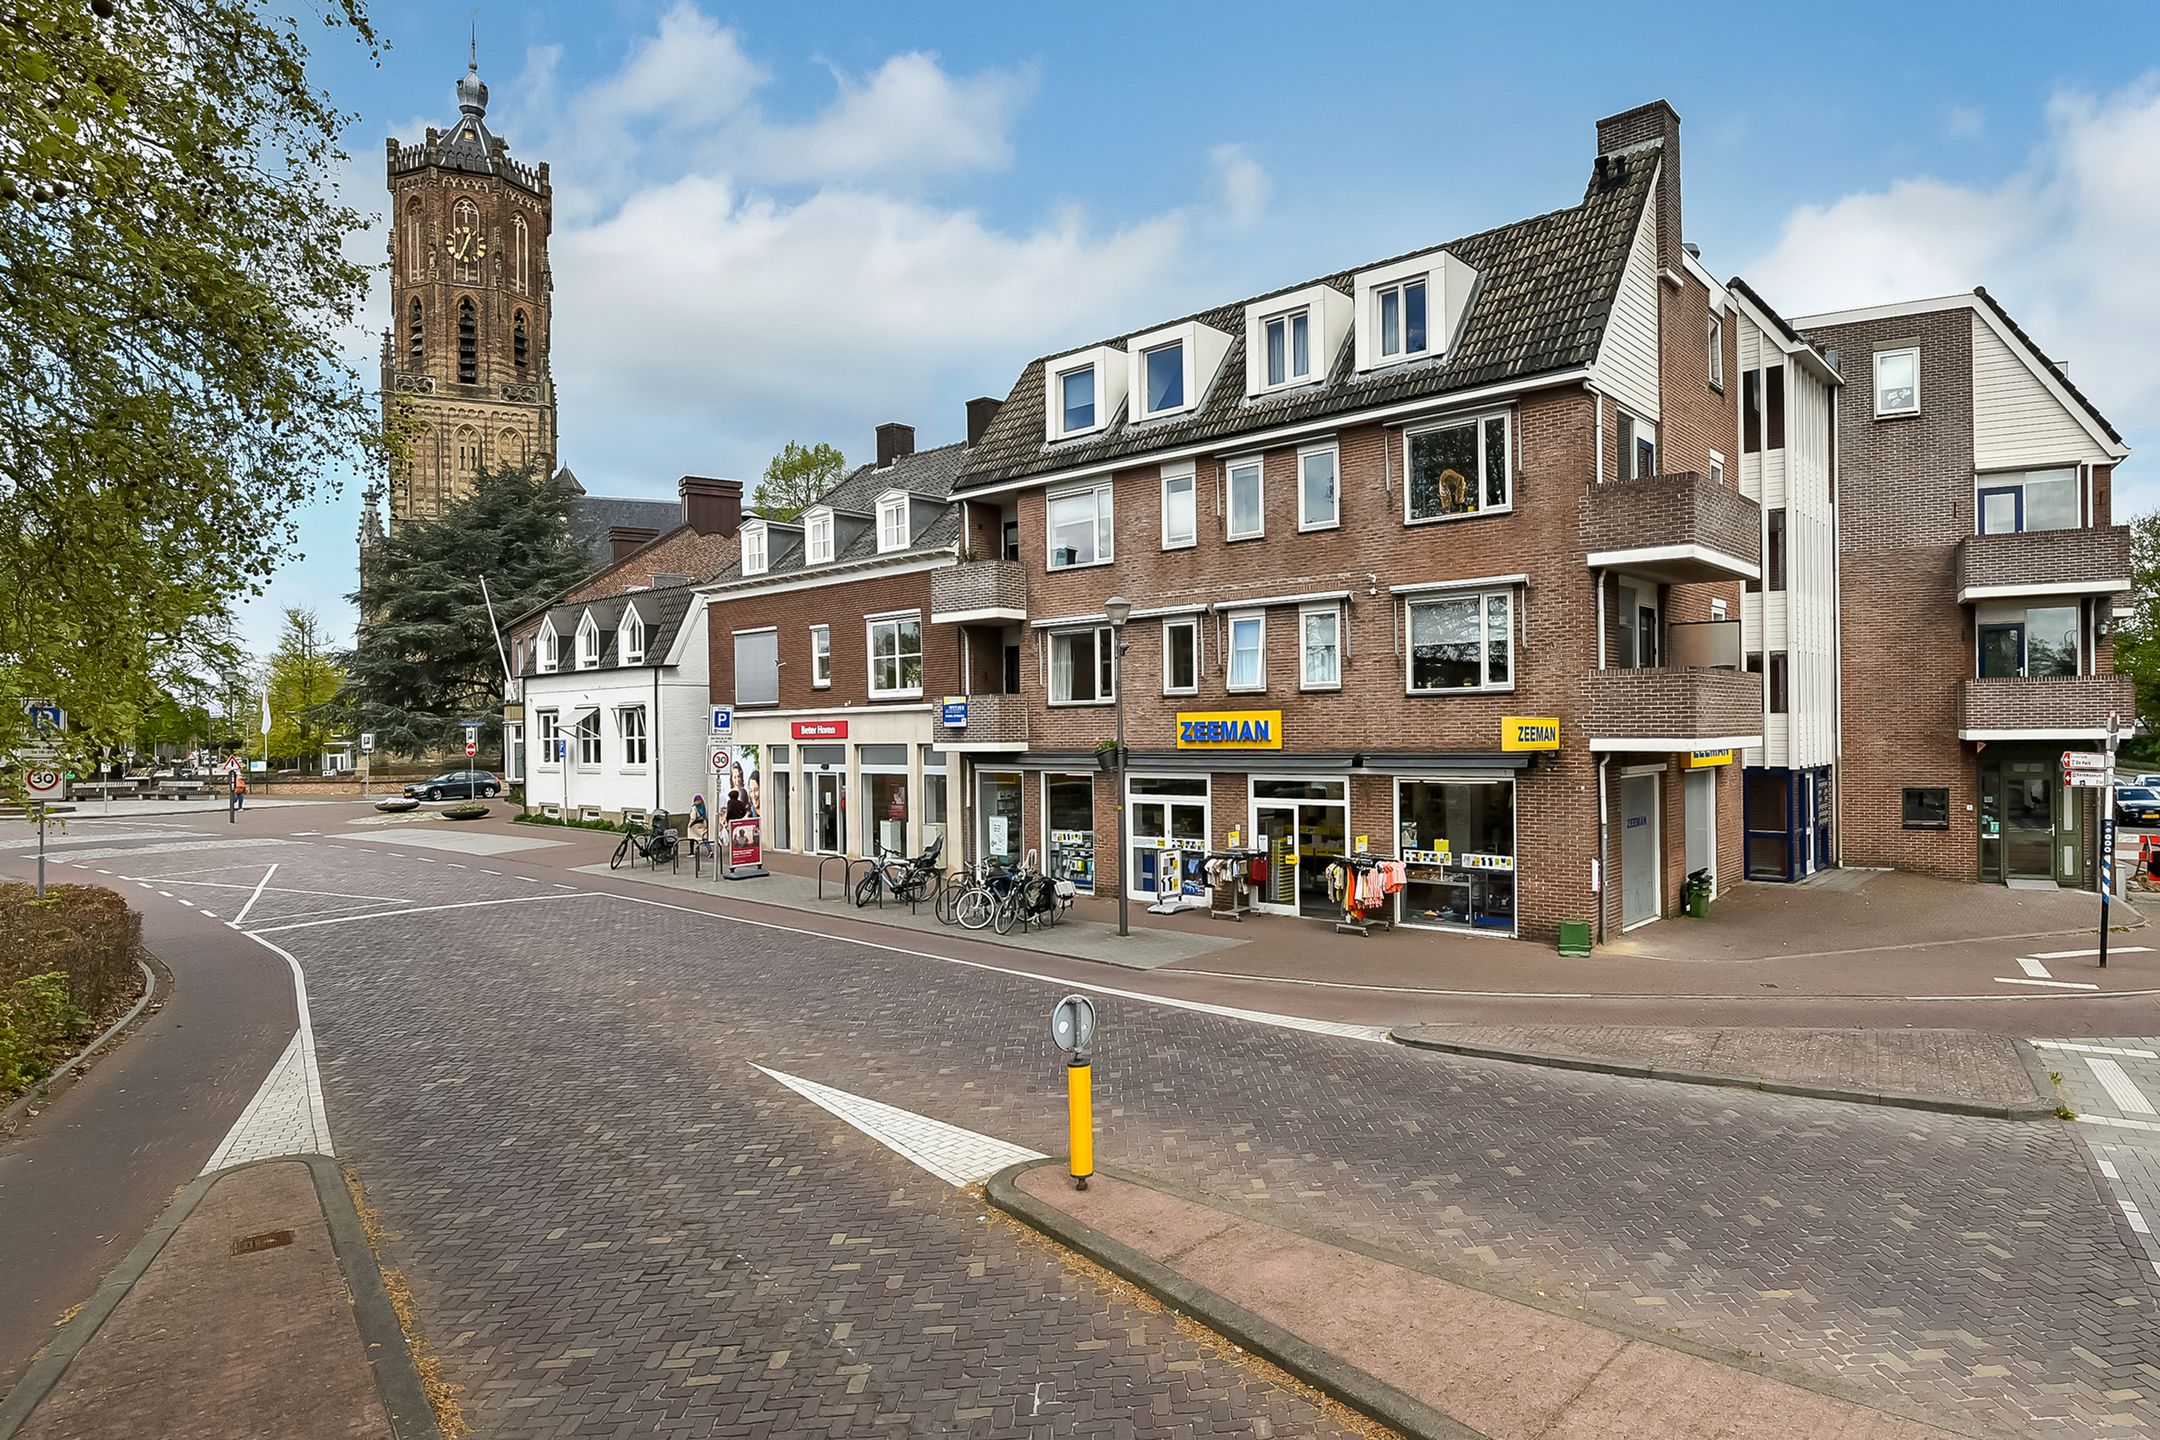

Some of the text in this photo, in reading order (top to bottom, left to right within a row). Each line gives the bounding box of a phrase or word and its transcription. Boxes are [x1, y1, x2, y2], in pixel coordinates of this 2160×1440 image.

[718, 713, 727, 726] P
[1180, 719, 1269, 741] ZEEMAN
[1518, 726, 1556, 742] ZEEMAN
[715, 756, 727, 764] 30
[33, 772, 54, 784] 30
[1627, 816, 1647, 829] ZEEMAN
